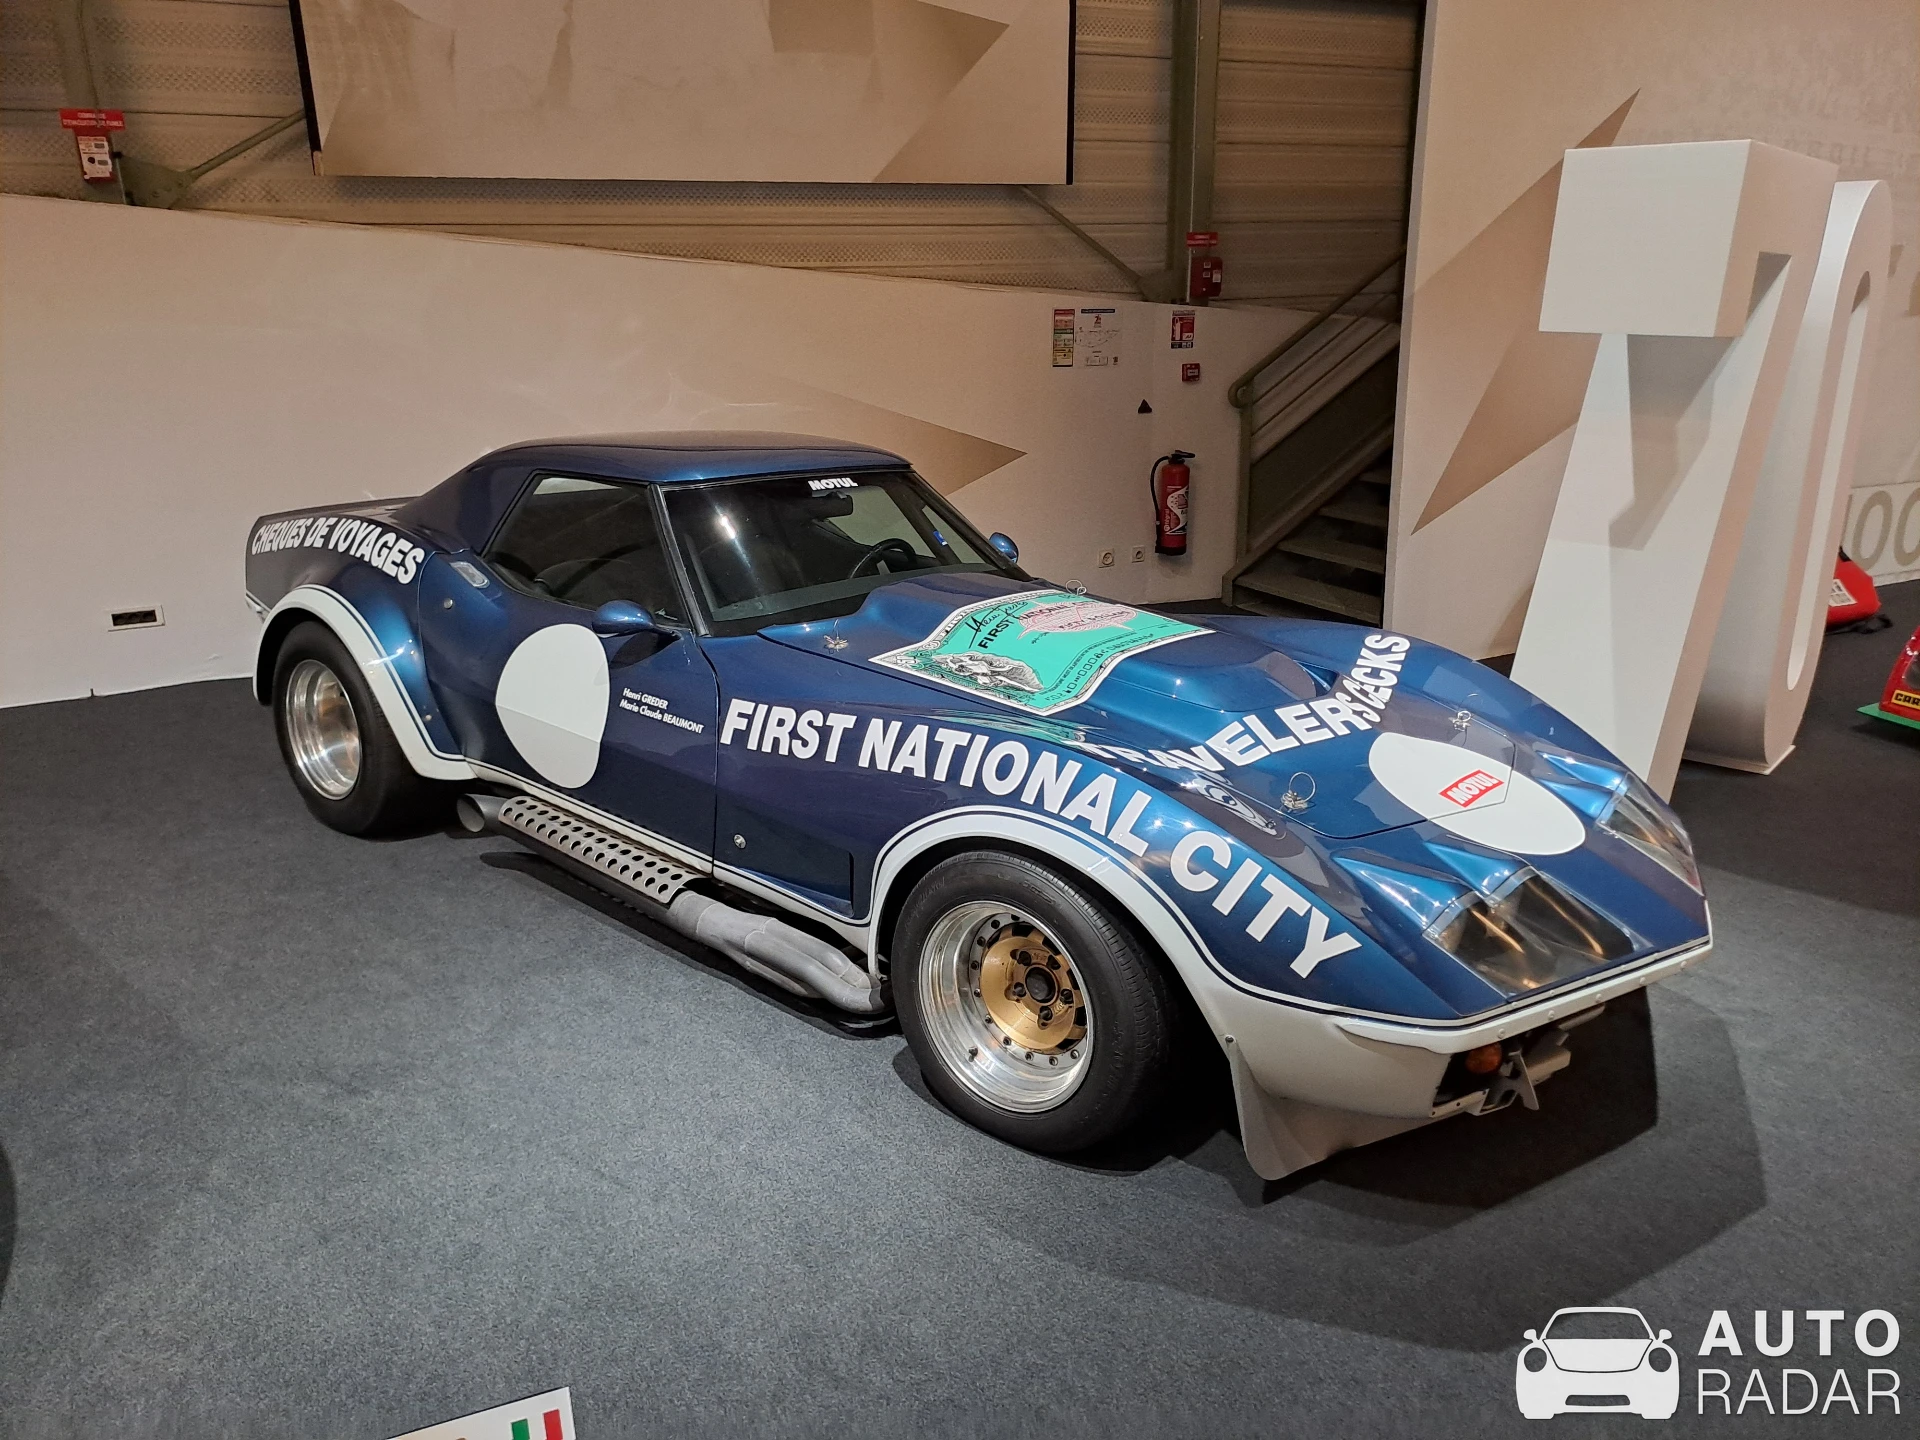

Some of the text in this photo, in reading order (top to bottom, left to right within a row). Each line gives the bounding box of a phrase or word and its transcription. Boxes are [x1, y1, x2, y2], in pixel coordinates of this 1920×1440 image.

[807, 477, 859, 491] MOTUL
[251, 517, 426, 585] CHEQUES DE VOYAGES
[977, 618, 1015, 650] FIRST
[622, 687, 669, 710] Henri GREDER
[1080, 634, 1411, 773] TRAVELERS CCKS
[619, 699, 704, 734] Marie Claude BEAUMONT
[1446, 772, 1500, 805] MOTUL
[720, 698, 1362, 979] FIRST NATIONAL CITY
